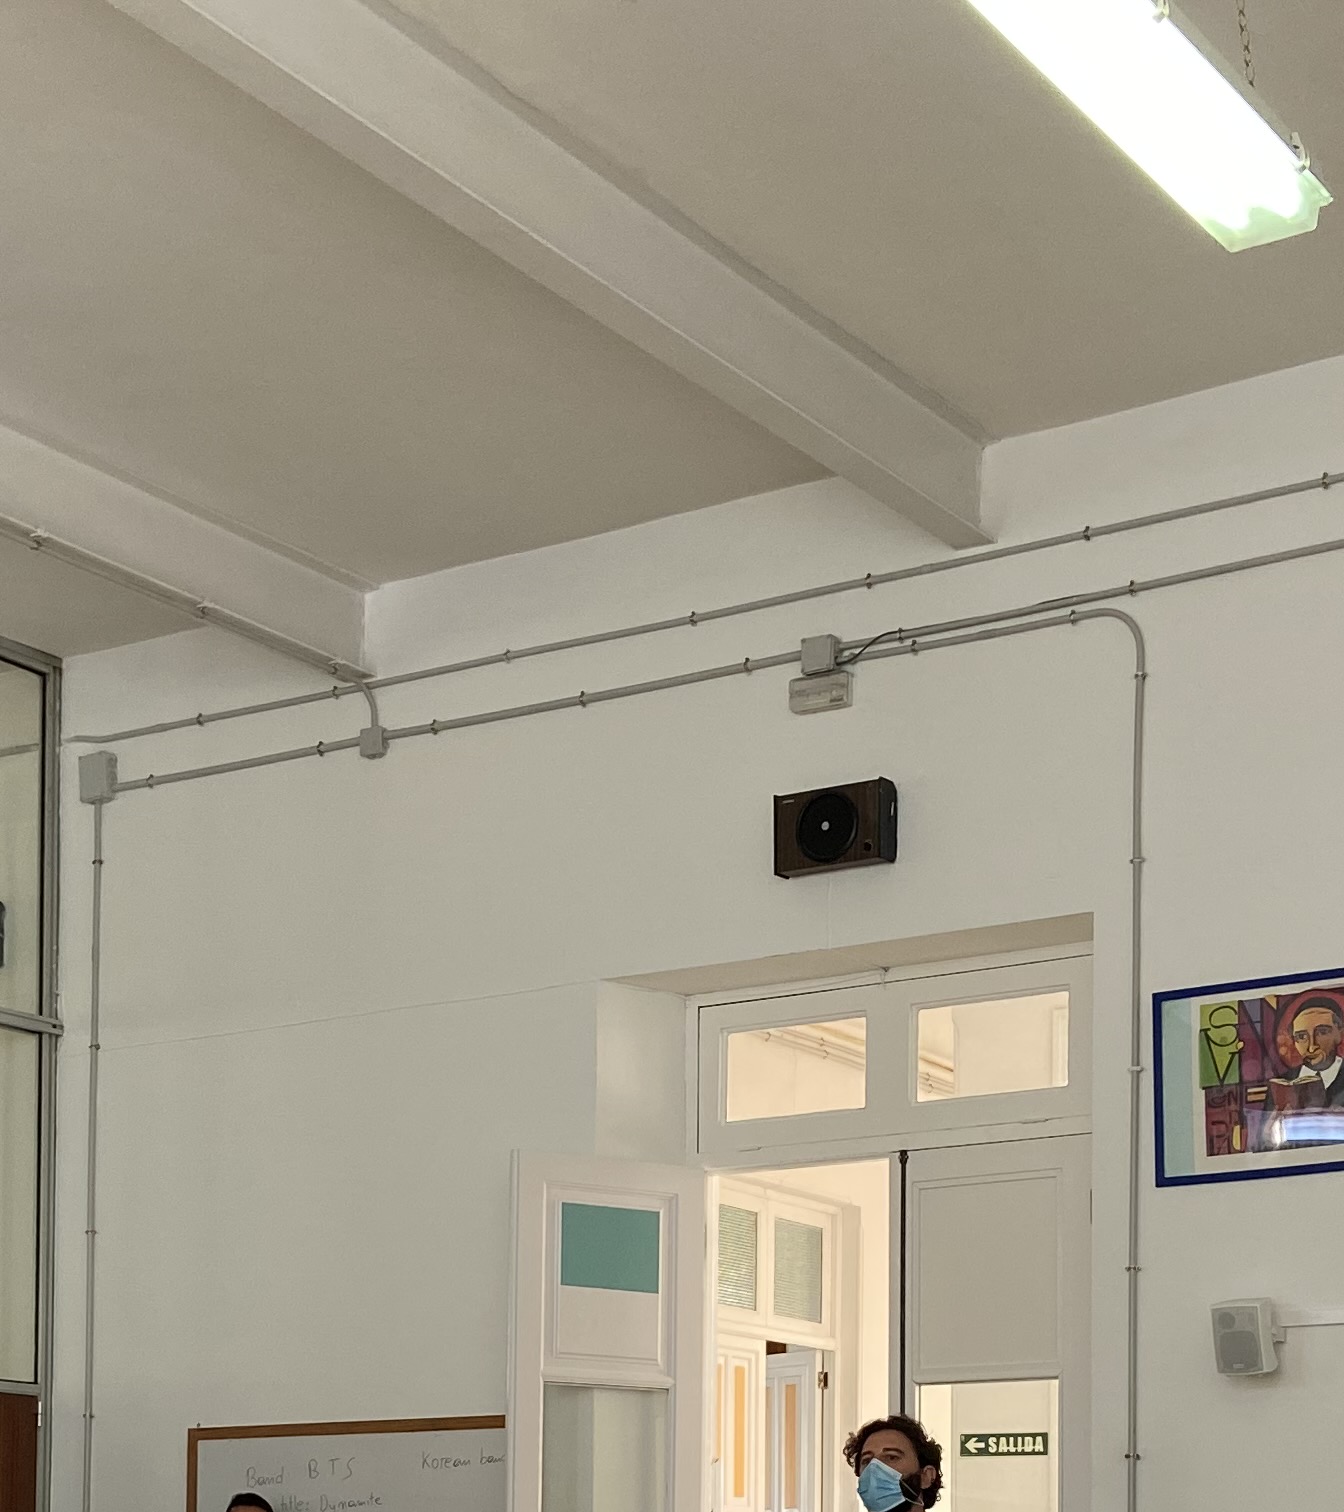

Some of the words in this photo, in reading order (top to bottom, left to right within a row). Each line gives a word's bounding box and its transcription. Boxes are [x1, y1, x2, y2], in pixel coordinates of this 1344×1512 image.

[988, 1435, 1044, 1453] SALIDA
[246, 1467, 284, 1488] Band
[421, 1451, 471, 1470] Korean
